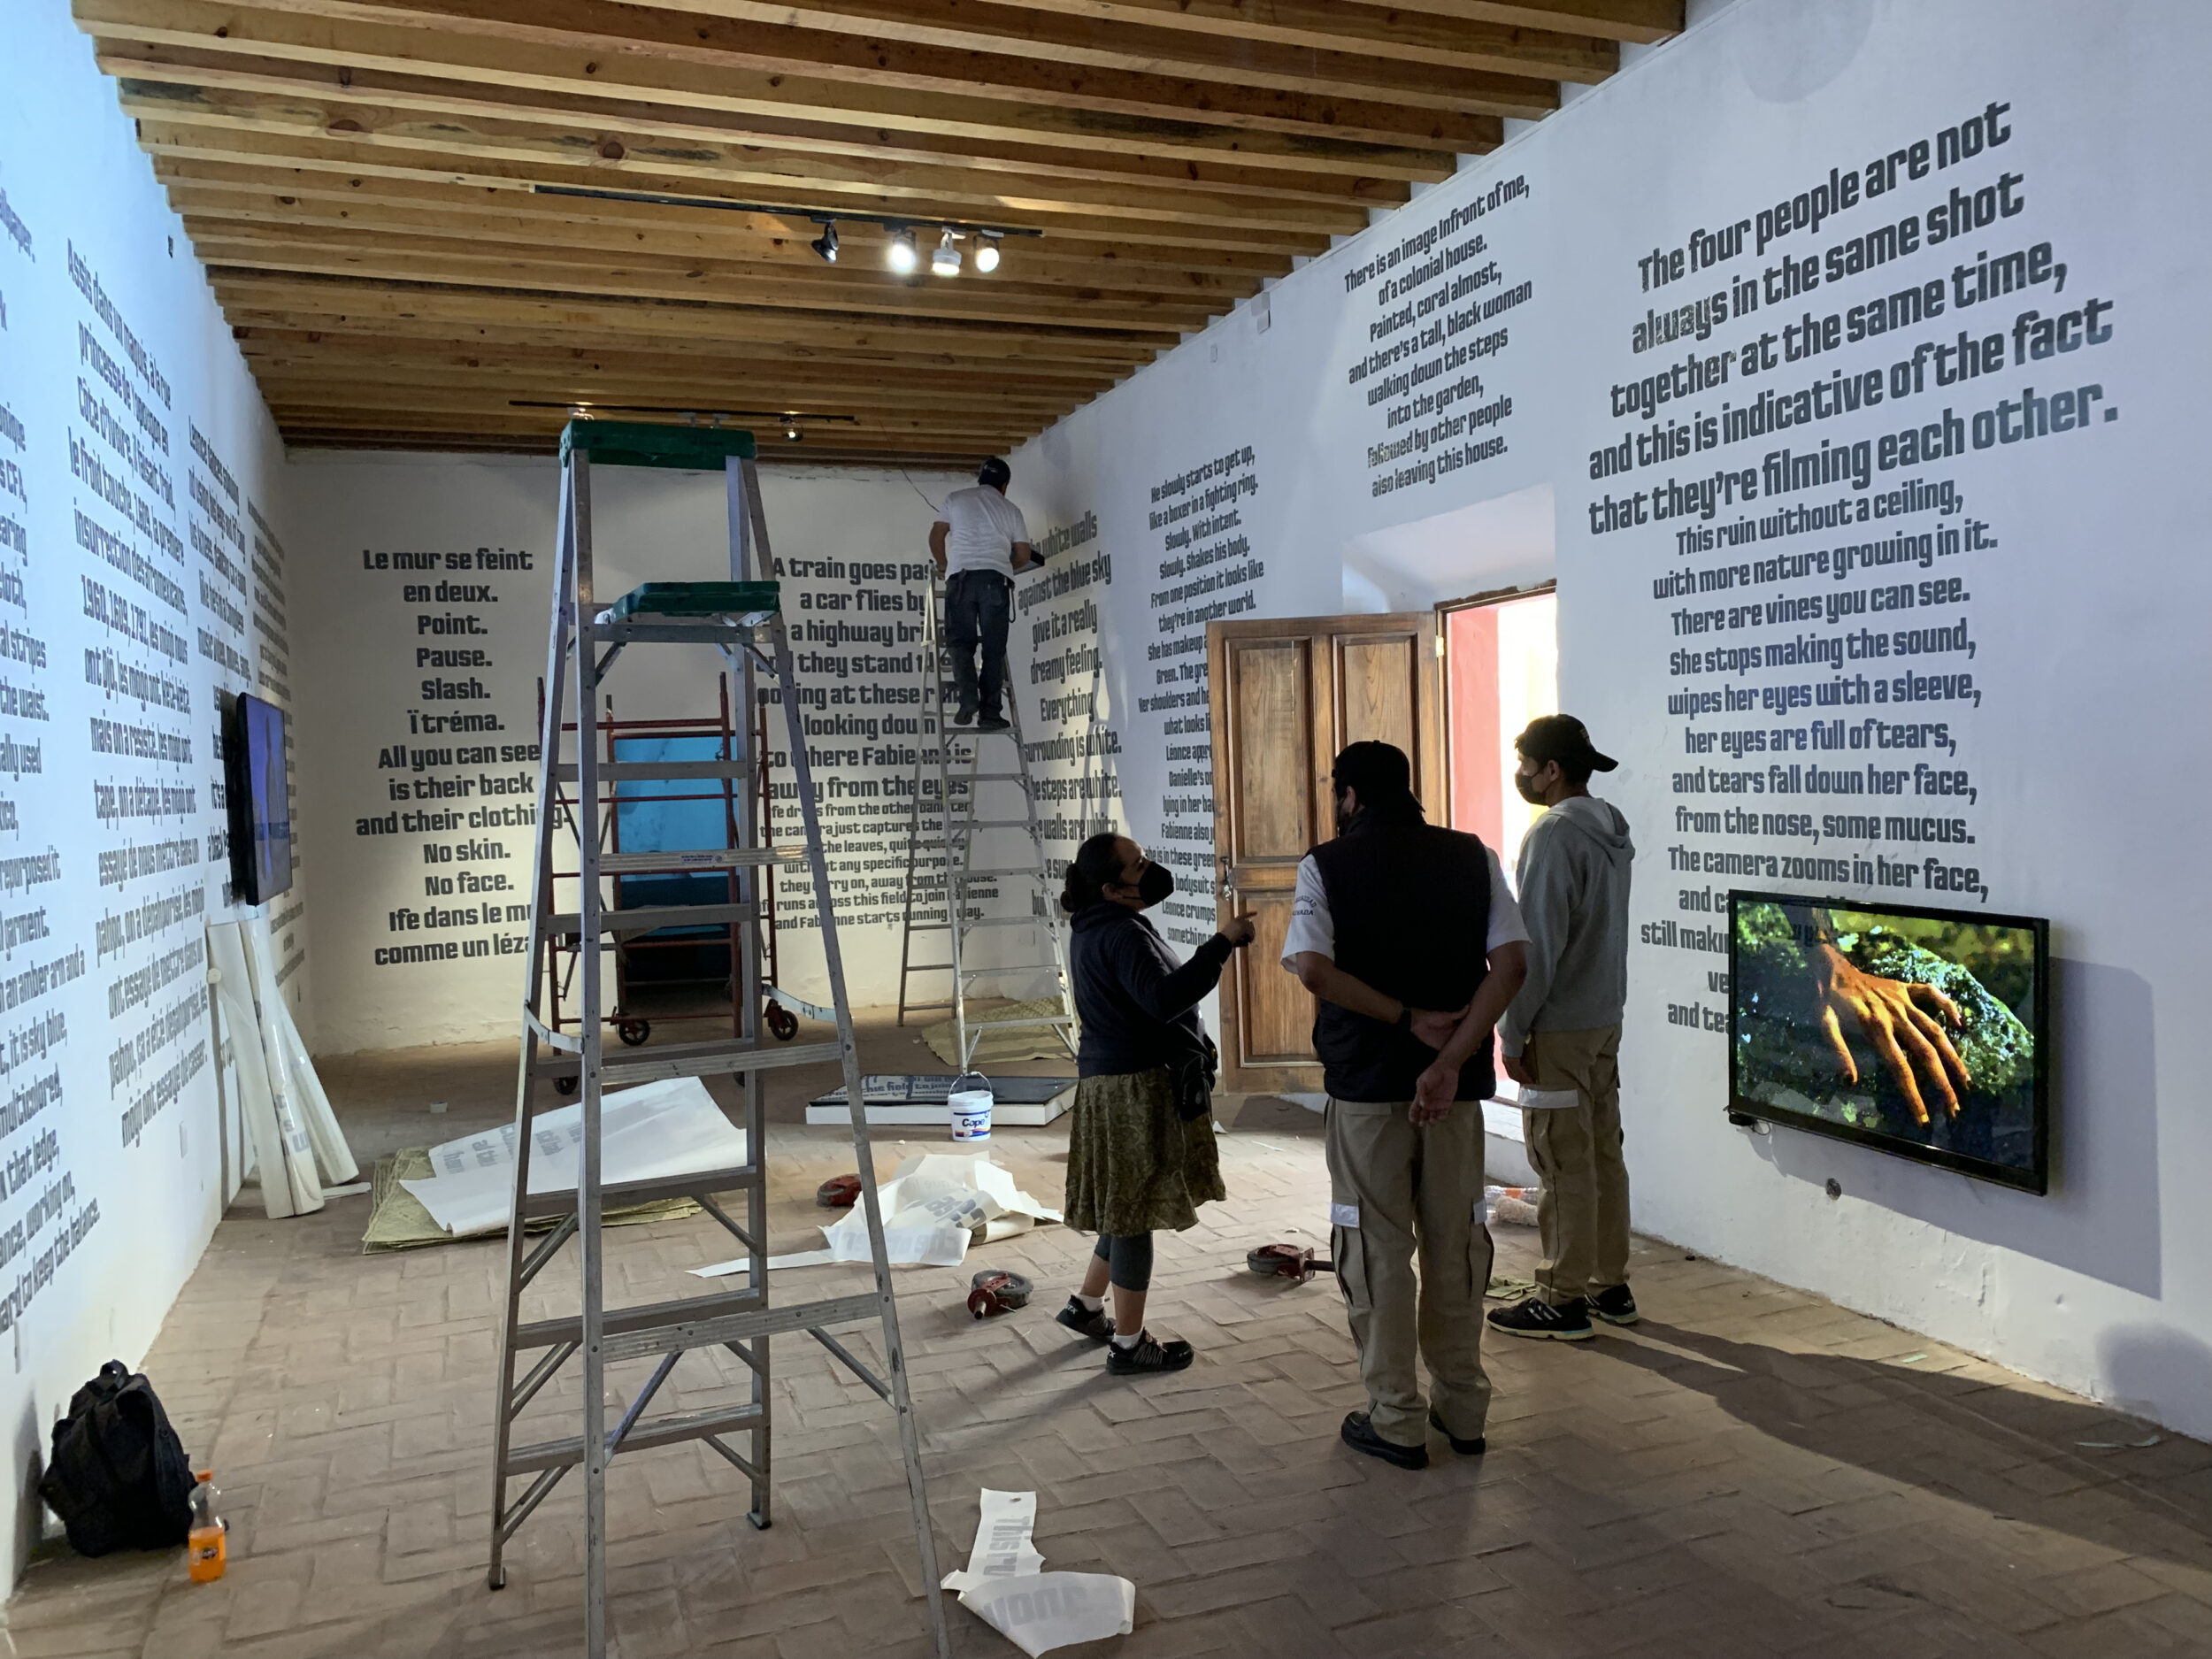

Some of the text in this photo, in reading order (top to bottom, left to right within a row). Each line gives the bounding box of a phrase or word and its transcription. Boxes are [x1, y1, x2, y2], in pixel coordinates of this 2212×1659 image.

[1638, 102, 2010, 293] The four people are not
[1345, 263, 1375, 293] There
[1377, 254, 1386, 275] is
[1387, 247, 1401, 269] an
[1402, 227, 1437, 256] image
[1487, 180, 1503, 211] of
[1503, 175, 1529, 203] me,
[1379, 234, 1487, 305] of a colonial house.
[1632, 173, 2024, 353] always in the same shot
[1371, 261, 1502, 342] Painted, coral almost,
[1611, 242, 2067, 419] together at the same time,
[1368, 328, 1508, 406] walking down the steps
[1590, 298, 2113, 480] and this is indicative of the fact
[1388, 375, 1483, 428] into the garden,
[1151, 446, 1255, 503] He slowly starts to get up,
[1589, 384, 2117, 534] that they're filming each other.
[1165, 509, 1241, 550] Slowly. With intent.
[1676, 478, 1962, 555] This ruin without a ceiling,
[363, 548, 533, 570] Le mur se feint
[773, 557, 896, 585] A train goes
[1654, 518, 1997, 599] with more nature growing in it.
[403, 580, 498, 602] en deux.
[800, 593, 812, 609] a
[816, 594, 852, 610] car
[856, 589, 902, 611] flies
[1159, 589, 1256, 634] they're in another world.
[81, 573, 109, 639] 1960,
[109, 589, 131, 648] 1609,
[131, 603, 149, 657] 1791,
[418, 612, 488, 634] Point.
[1033, 599, 1097, 652] give it a really
[417, 648, 492, 667] Pause.
[1031, 643, 1102, 684] dreamy feeling.
[1671, 618, 1976, 676] She stops making the sound,
[19, 682, 50, 722] waist.
[422, 677, 490, 700] Slash.
[1041, 687, 1094, 725] Everything
[1669, 670, 1981, 720] wipes her eyes with a sleeve,
[421, 710, 504, 733] tréma.
[804, 714, 878, 741] looking
[1686, 718, 1956, 758] her eyes are full of tears,
[389, 772, 534, 801] is their back
[1676, 806, 1975, 845] from the nose, some mucus.
[424, 838, 511, 864] No skin.
[1668, 844, 1988, 902] The camera zooms in her face,
[426, 872, 513, 895] No face.
[109, 975, 124, 1019] ont
